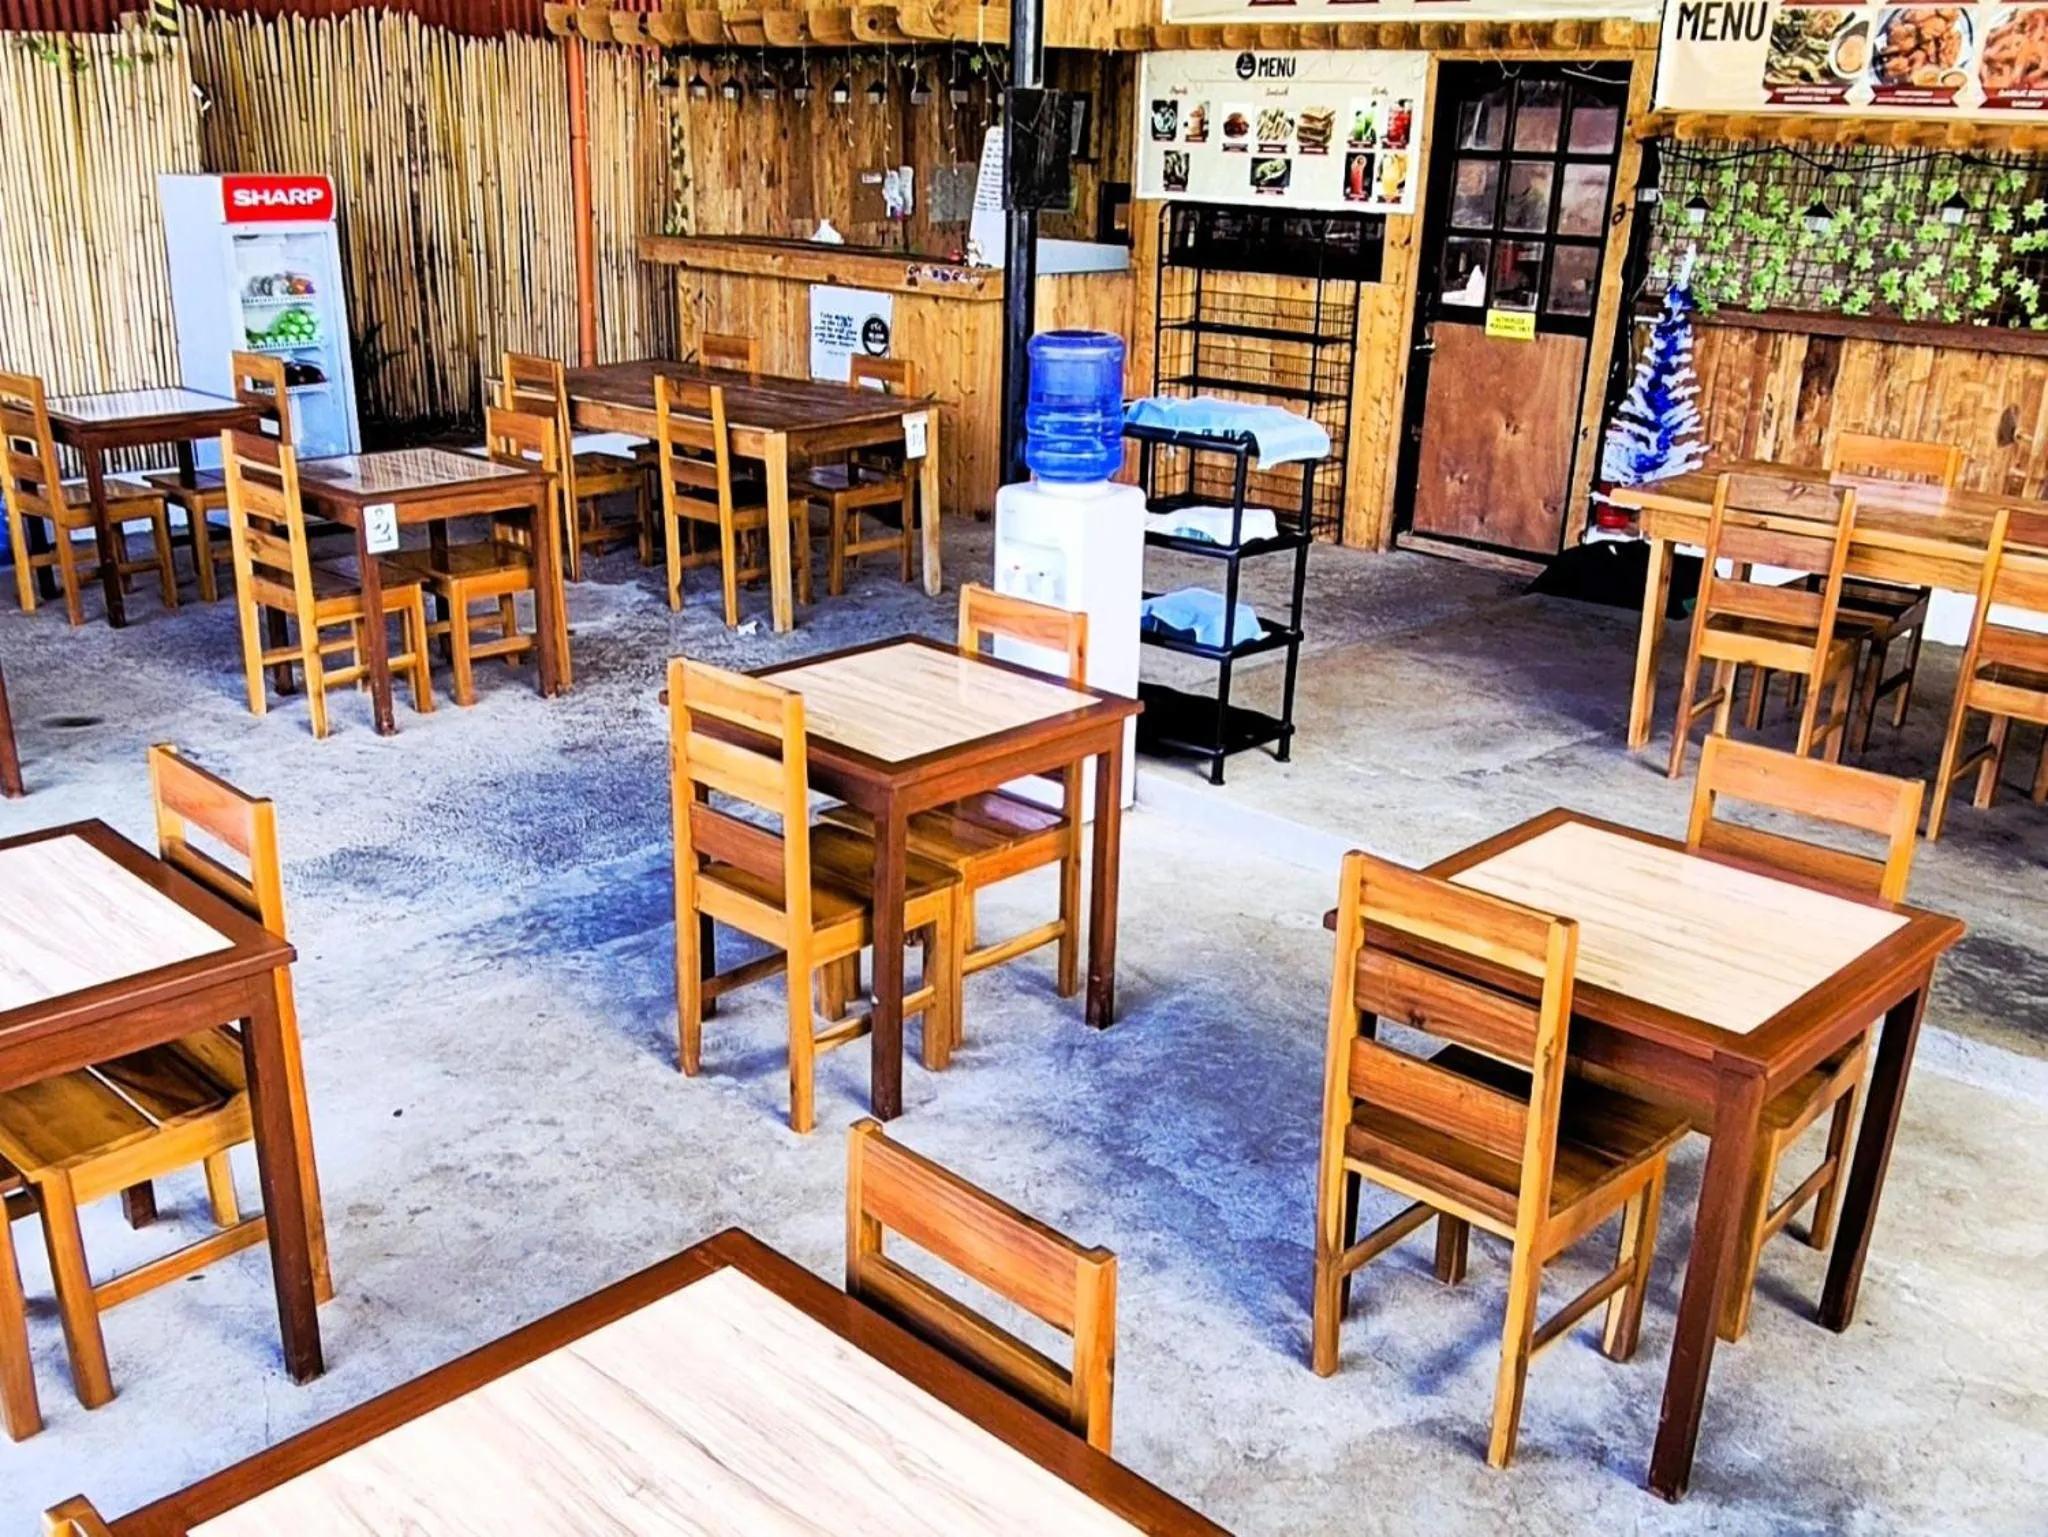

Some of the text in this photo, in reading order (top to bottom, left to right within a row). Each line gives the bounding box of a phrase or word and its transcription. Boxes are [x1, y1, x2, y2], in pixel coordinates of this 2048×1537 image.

[1676, 1, 1768, 42] MENU
[1258, 56, 1296, 78] MENU
[233, 187, 324, 207] SHARP
[372, 521, 393, 545] 2
